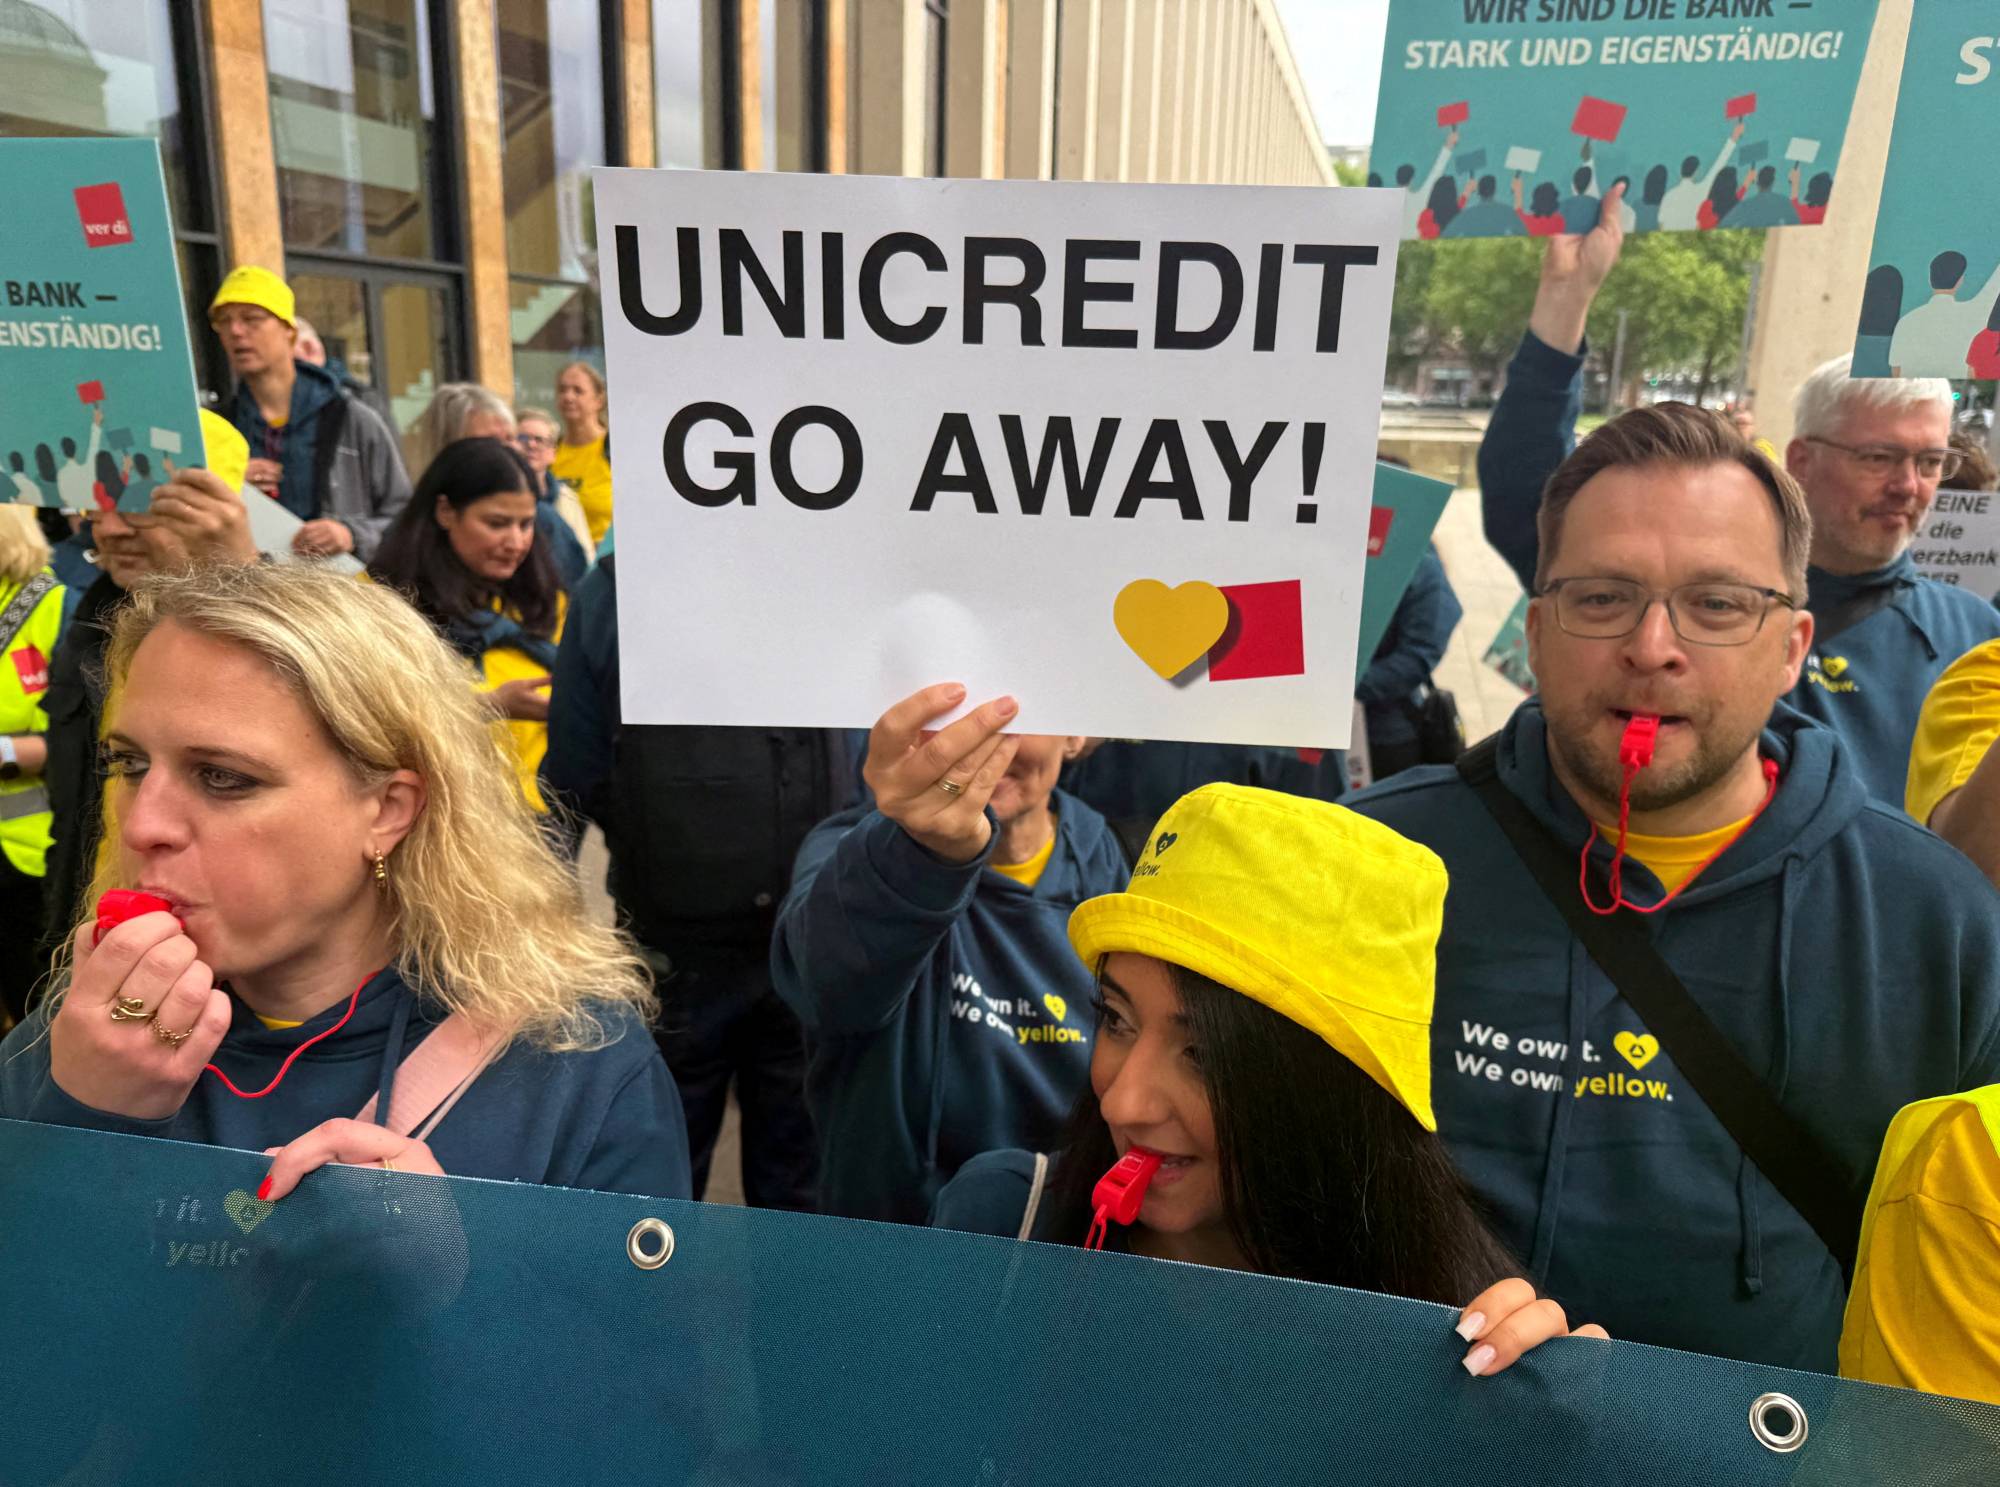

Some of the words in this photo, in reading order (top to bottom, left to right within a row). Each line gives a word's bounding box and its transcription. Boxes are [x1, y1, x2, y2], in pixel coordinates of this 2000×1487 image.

[1463, 0, 1528, 24] WIR
[1535, 0, 1616, 22] SIND
[1623, 0, 1677, 20] DIE
[1685, 0, 1776, 19] BANK
[1404, 39, 1513, 70] STARK
[1519, 37, 1593, 68] UND
[1598, 26, 1844, 65] EIGENSTÄNDIG!
[1954, 36, 2000, 85] S
[5, 280, 87, 309] BANK
[614, 224, 1380, 354] UNICREDIT
[662, 401, 864, 512] GO
[908, 411, 1327, 524] AWAY!
[1930, 493, 1991, 515] EINE
[1929, 521, 1964, 540] die
[951, 972, 982, 997] We
[1017, 998, 1037, 1017] it.
[951, 1000, 982, 1023] We
[1017, 1023, 1087, 1045] yellow.
[1461, 1019, 1510, 1051] We
[1454, 1050, 1504, 1081] We
[1573, 1072, 1674, 1102] yellow.
